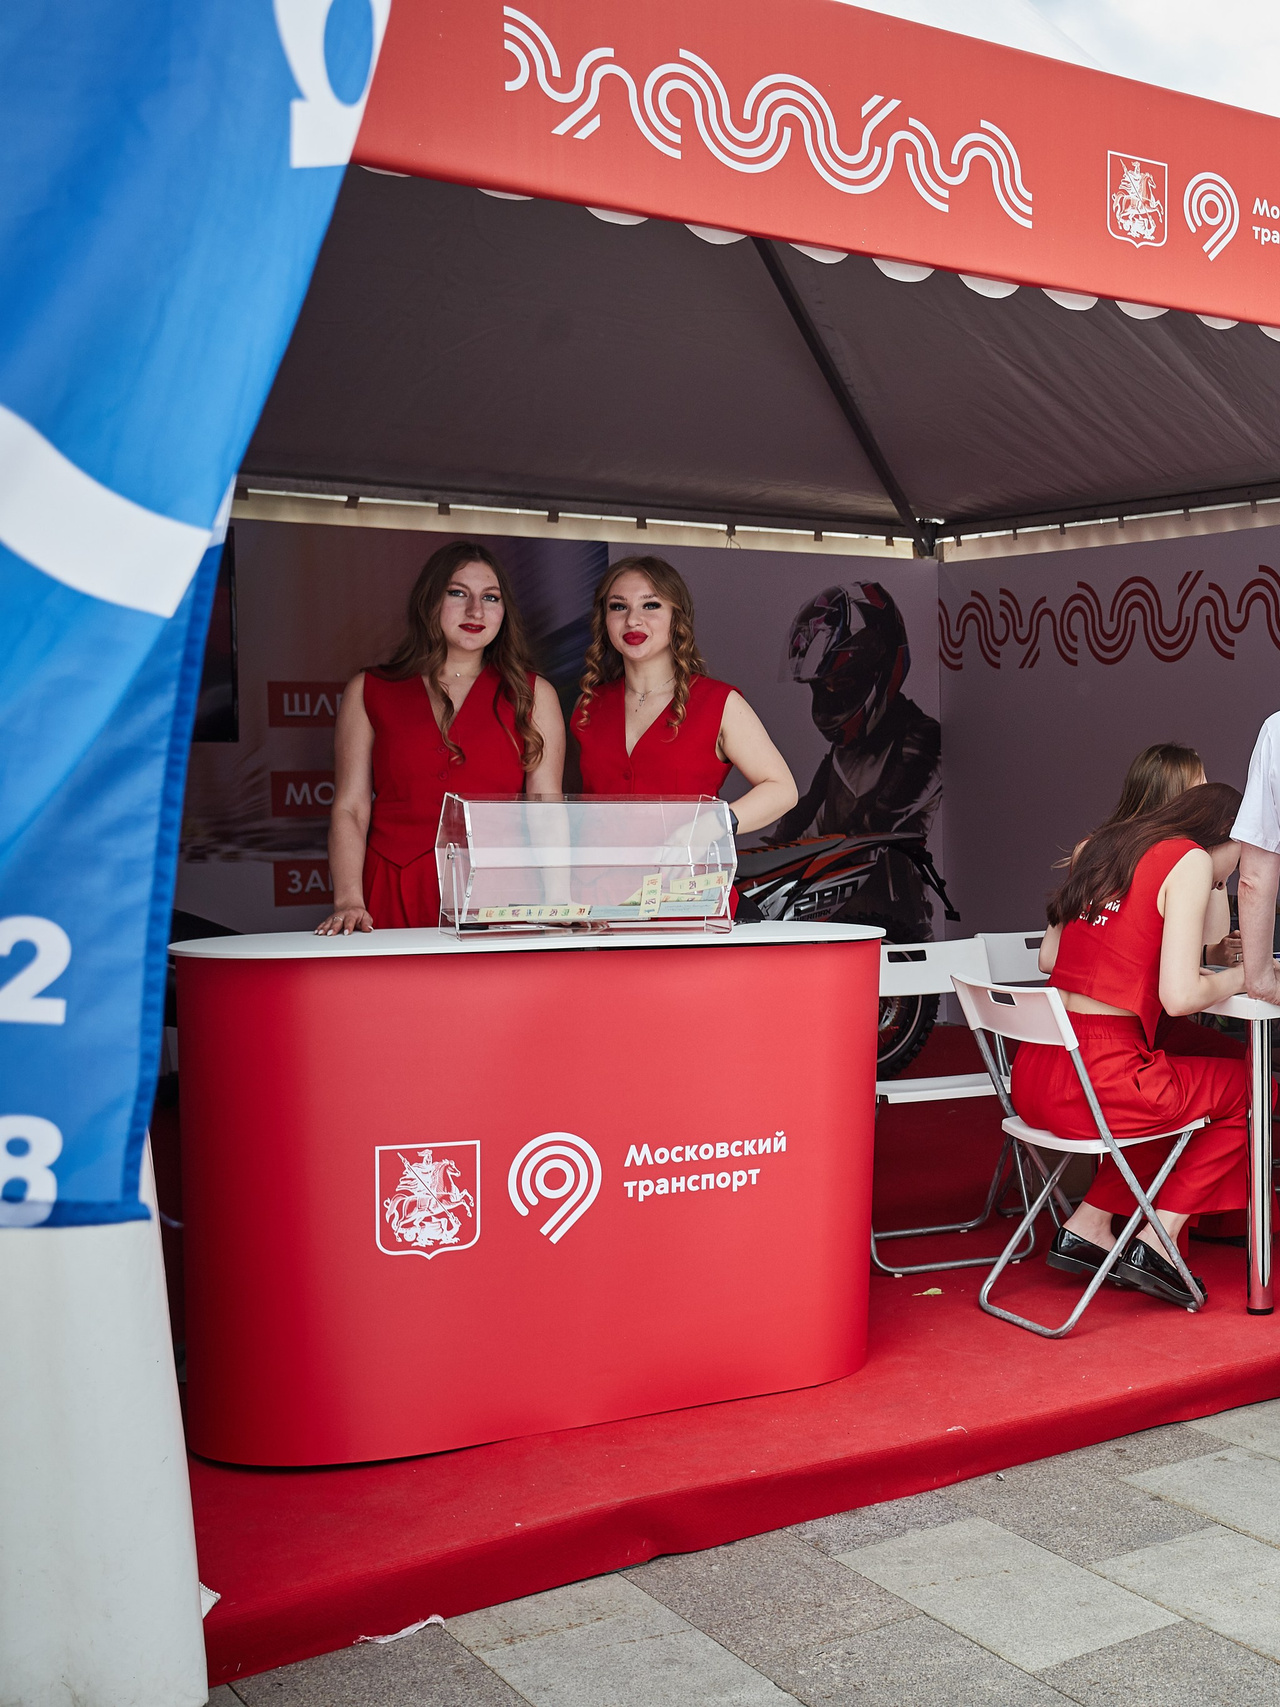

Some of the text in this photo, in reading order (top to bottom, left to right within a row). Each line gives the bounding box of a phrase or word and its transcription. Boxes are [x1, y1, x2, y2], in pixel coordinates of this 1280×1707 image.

[283, 693, 343, 717] ШЛ
[287, 869, 334, 894] ЗА
[624, 1130, 787, 1168] Московский
[623, 1168, 761, 1202] транспорт
